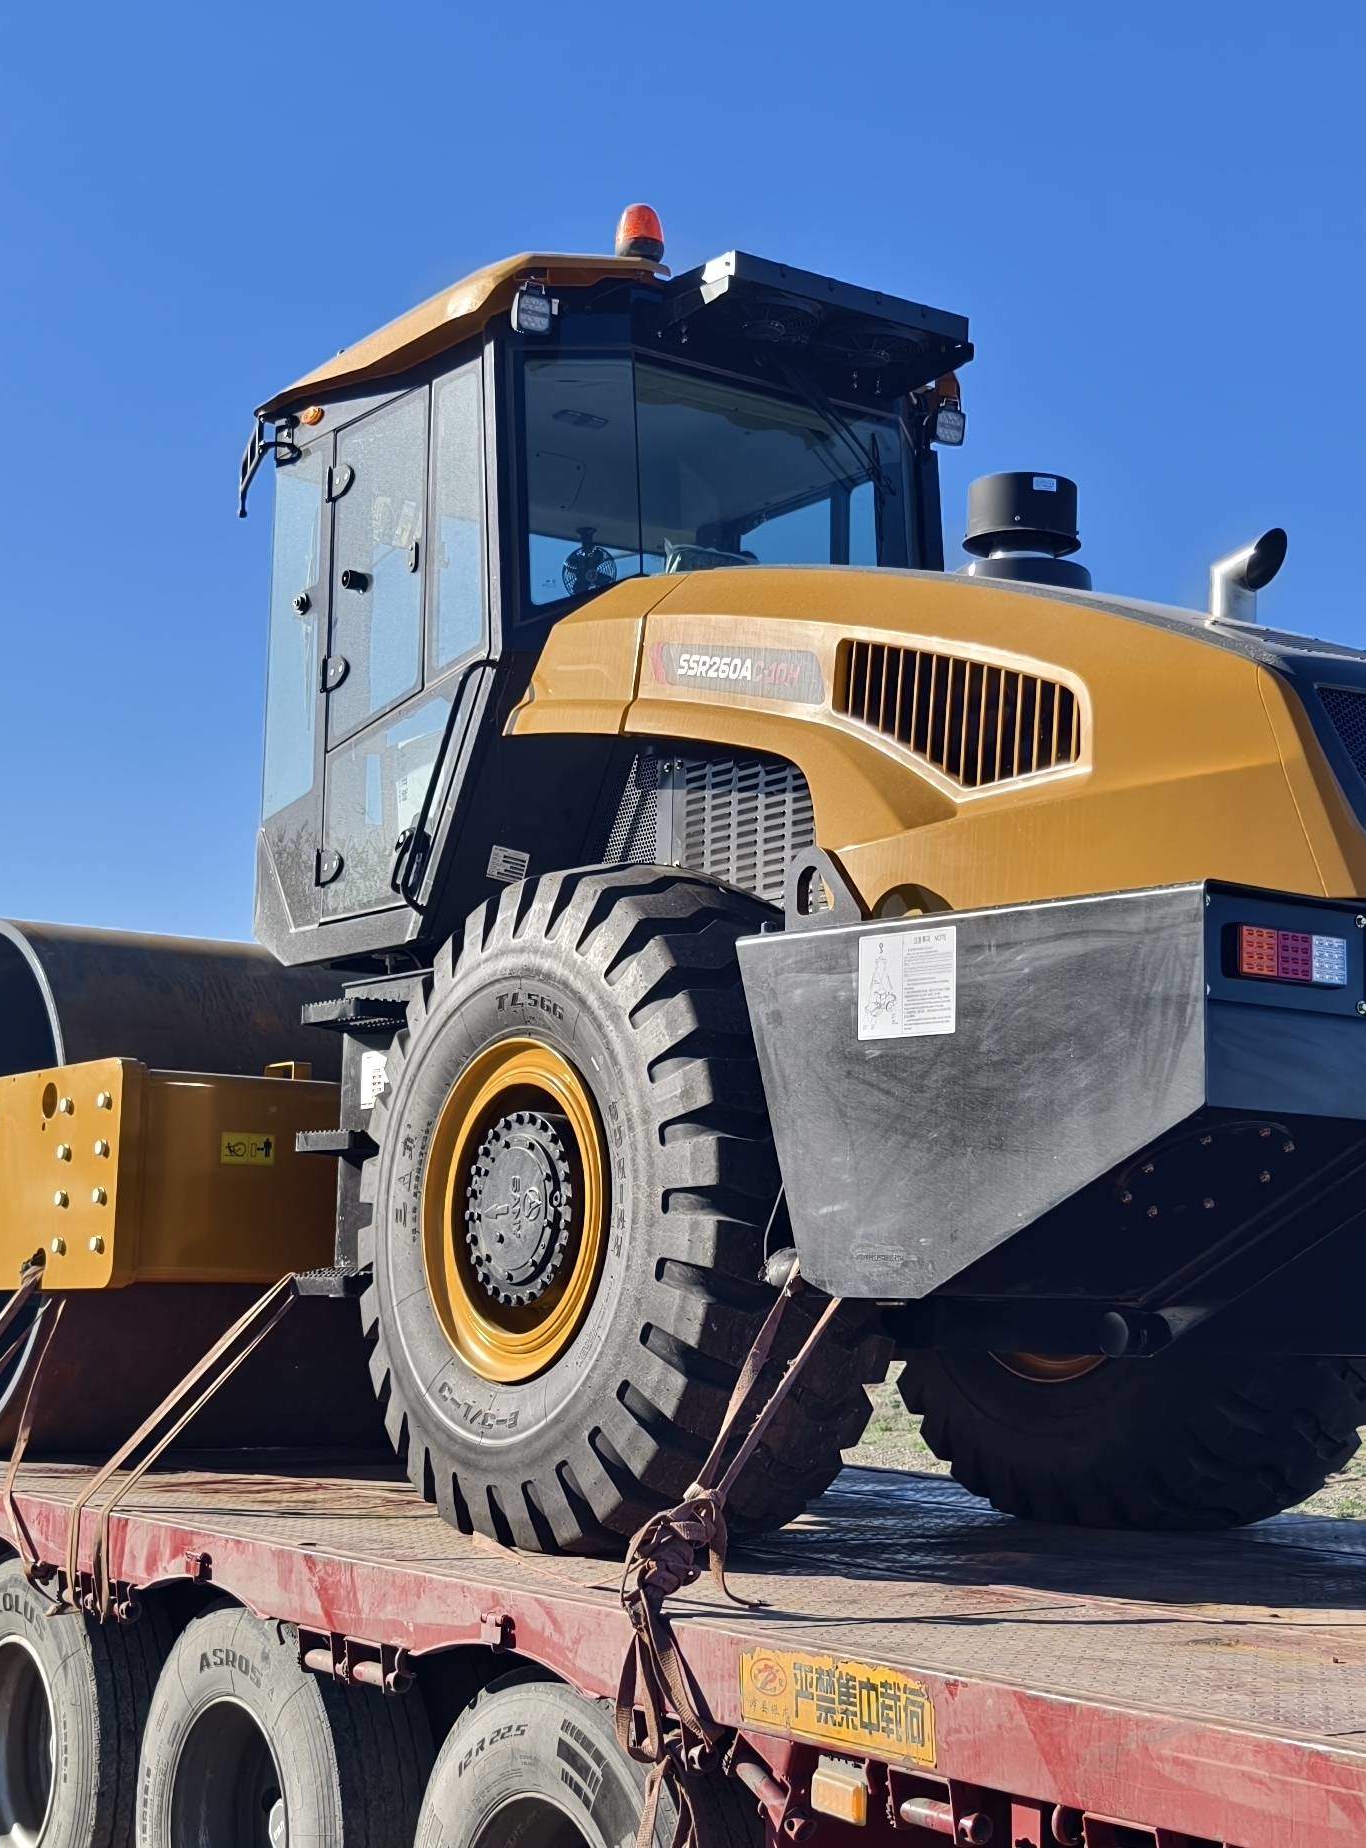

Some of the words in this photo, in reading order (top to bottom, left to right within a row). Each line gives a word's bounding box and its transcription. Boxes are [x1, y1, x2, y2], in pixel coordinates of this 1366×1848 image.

[438, 1382, 520, 1430] E-3/L-3
[793, 1662, 926, 1748] 严禁集中载荷
